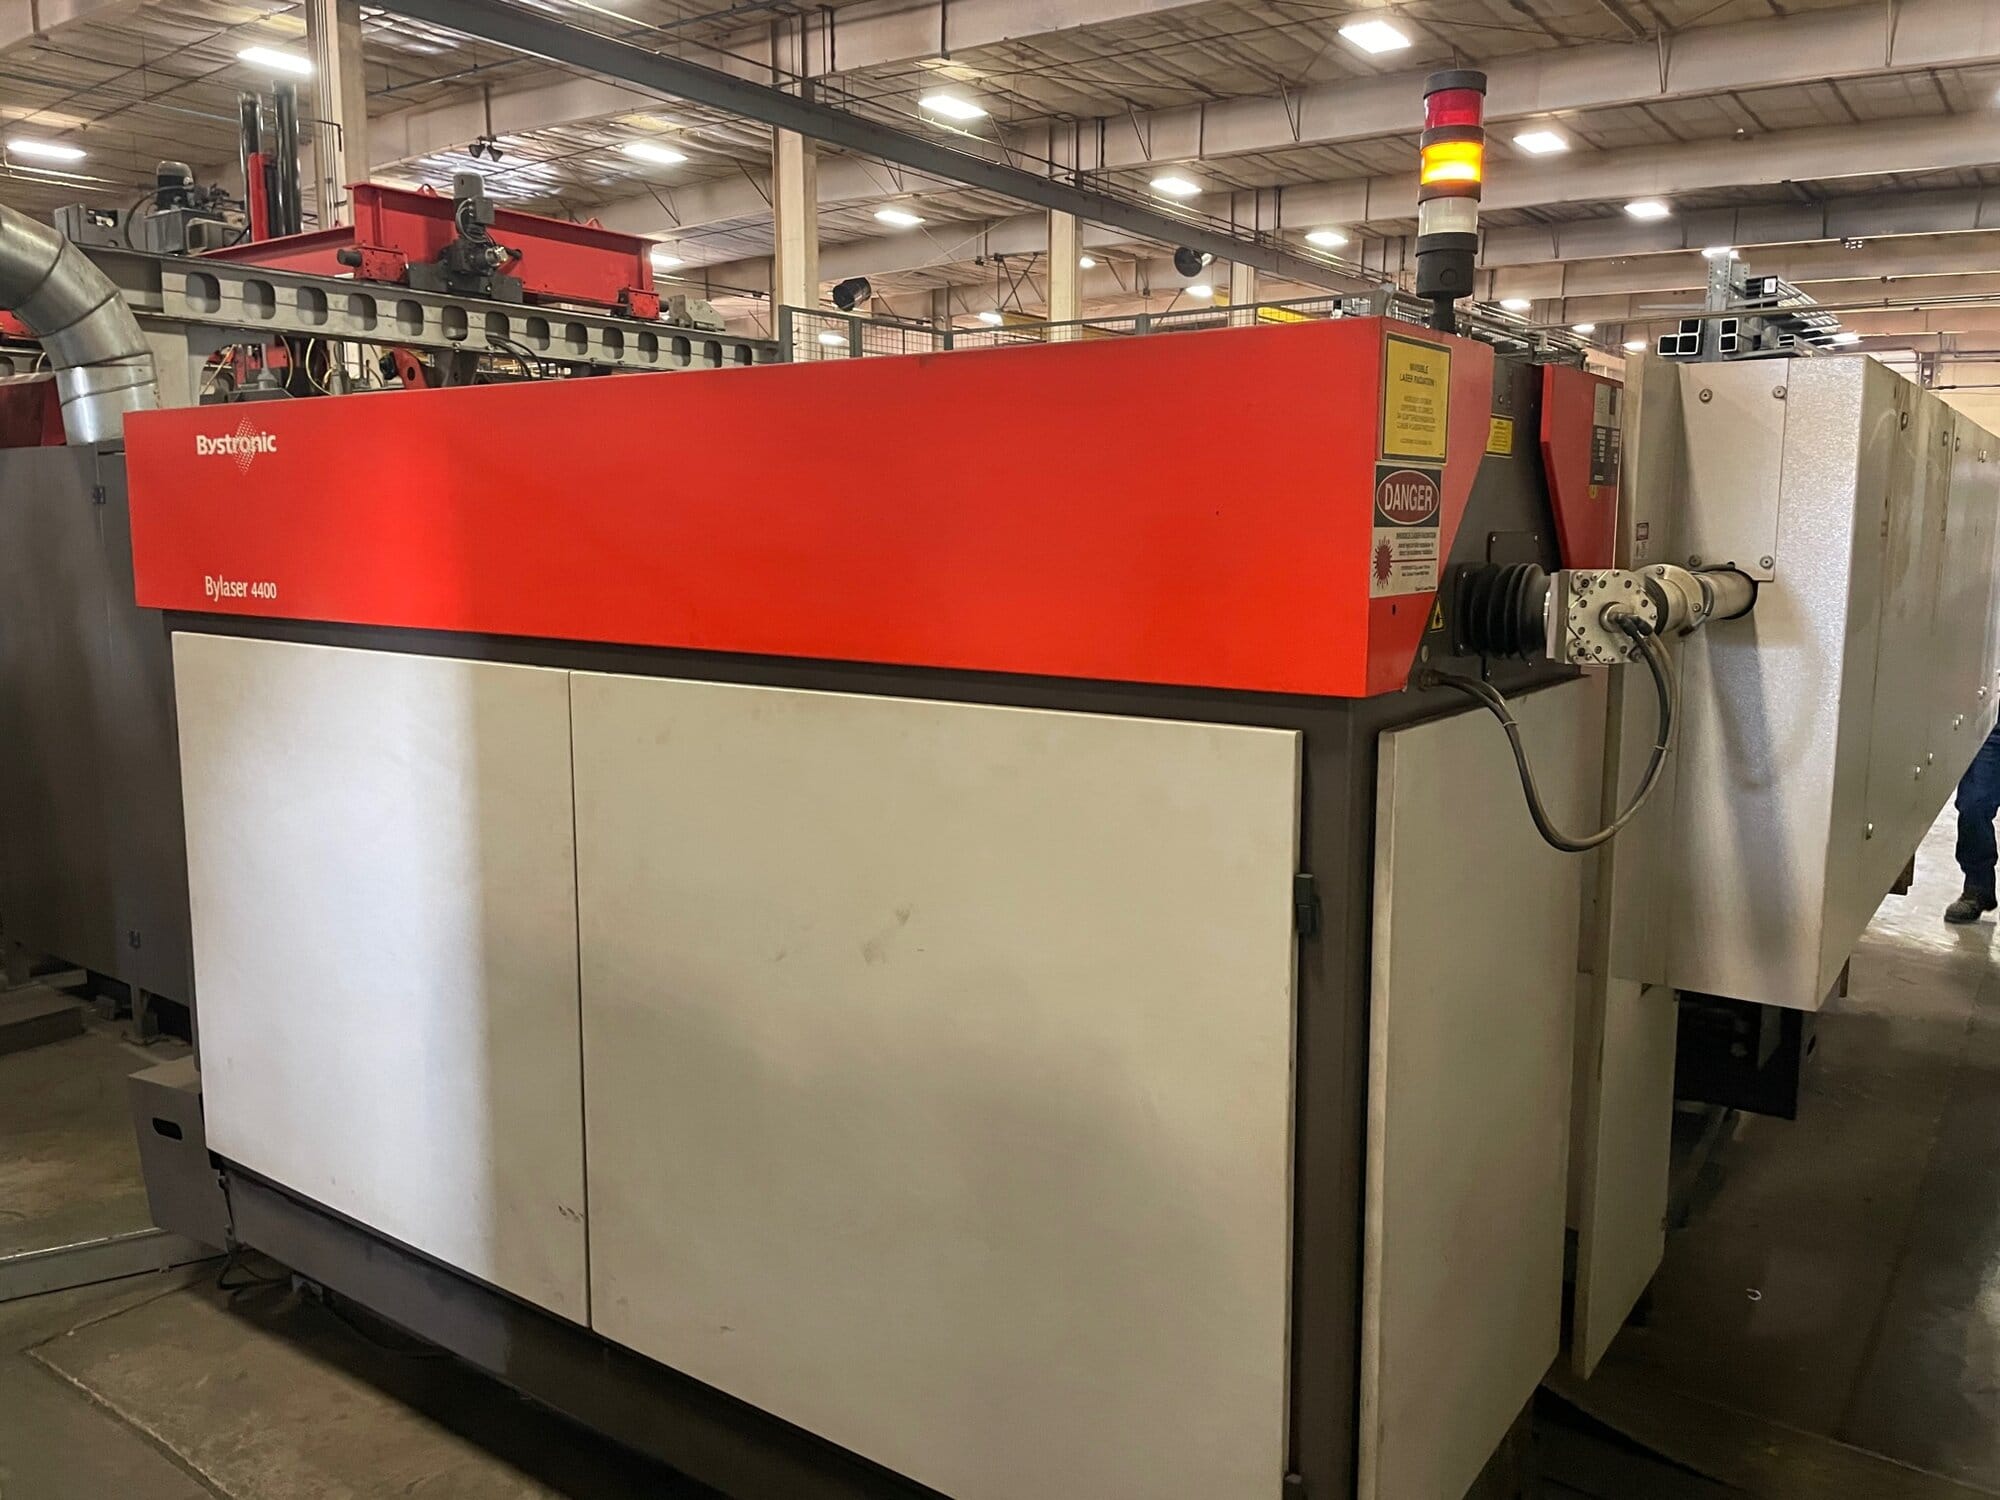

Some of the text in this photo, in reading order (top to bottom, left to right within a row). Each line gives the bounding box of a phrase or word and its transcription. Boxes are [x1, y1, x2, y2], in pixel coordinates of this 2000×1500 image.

[196, 432, 277, 455] Bystronic
[1384, 483, 1433, 511] DANGER
[205, 575, 277, 602] Bylaser 4400
